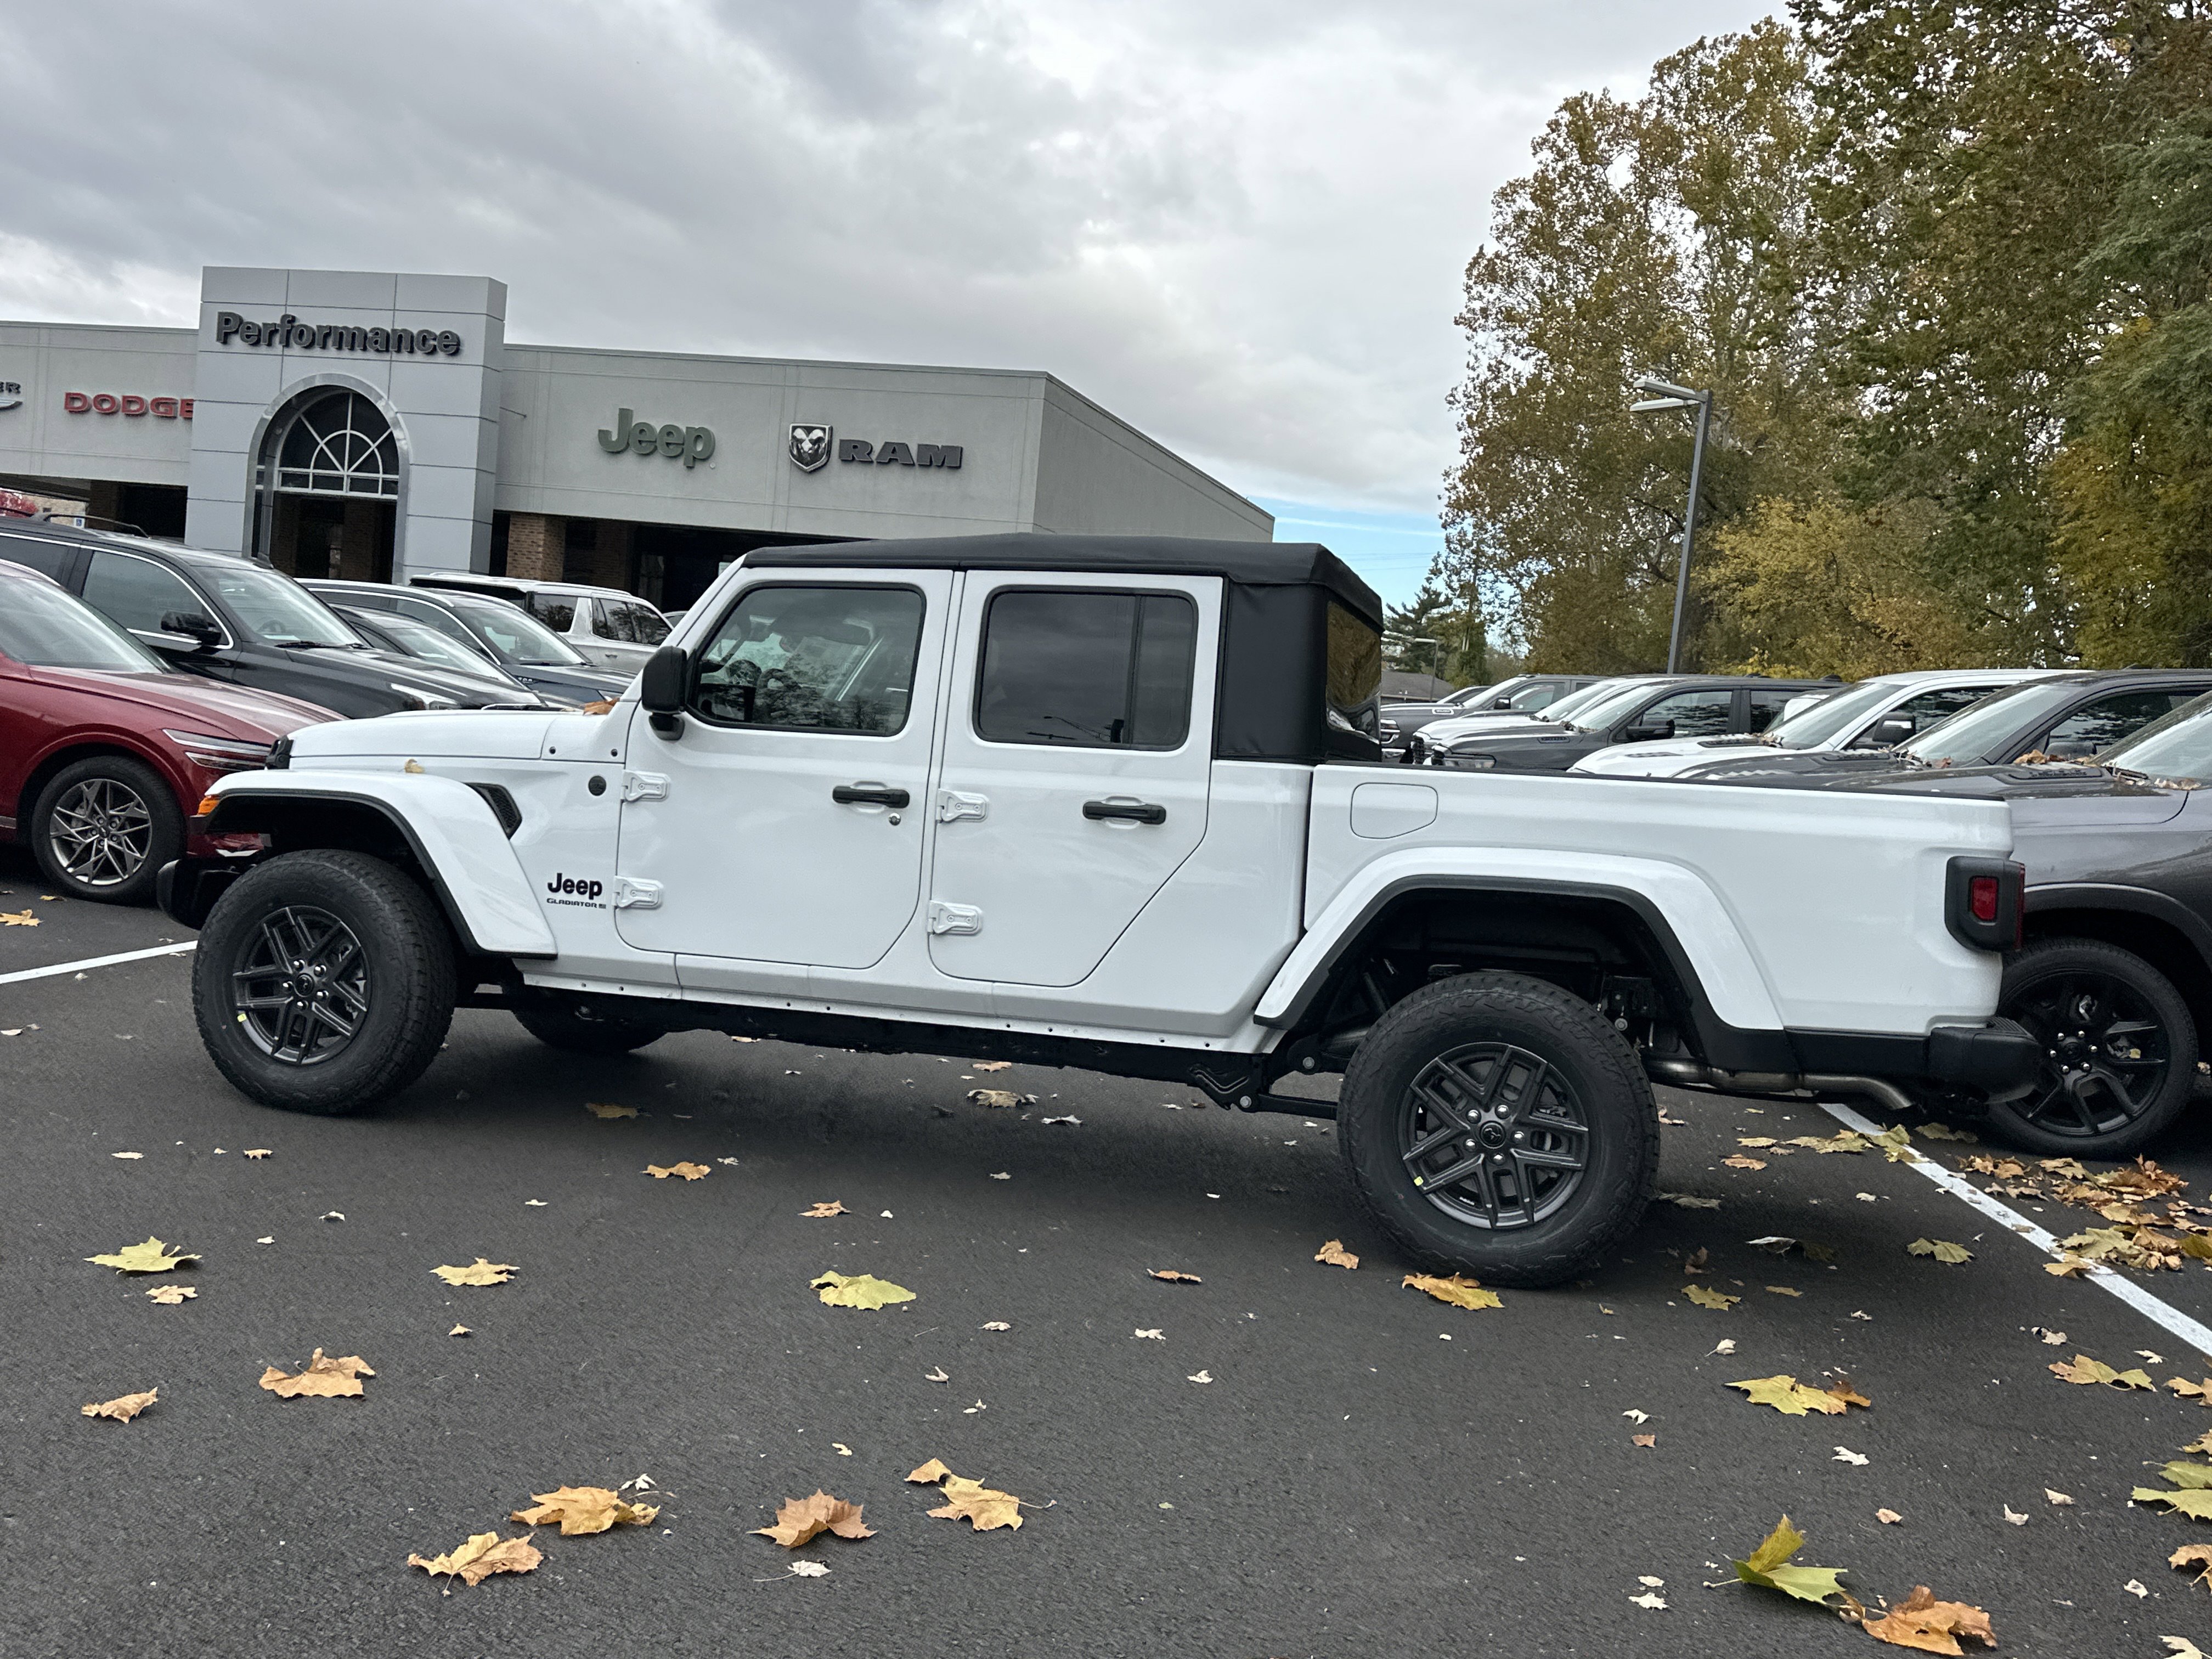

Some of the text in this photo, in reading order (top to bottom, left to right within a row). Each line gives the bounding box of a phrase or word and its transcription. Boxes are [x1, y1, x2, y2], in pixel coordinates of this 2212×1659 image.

[216, 311, 461, 356] Performance
[597, 408, 716, 468] Jeep
[838, 439, 962, 469] RAM
[548, 872, 602, 900] Jeep
[546, 898, 597, 909] GLADIATOR
